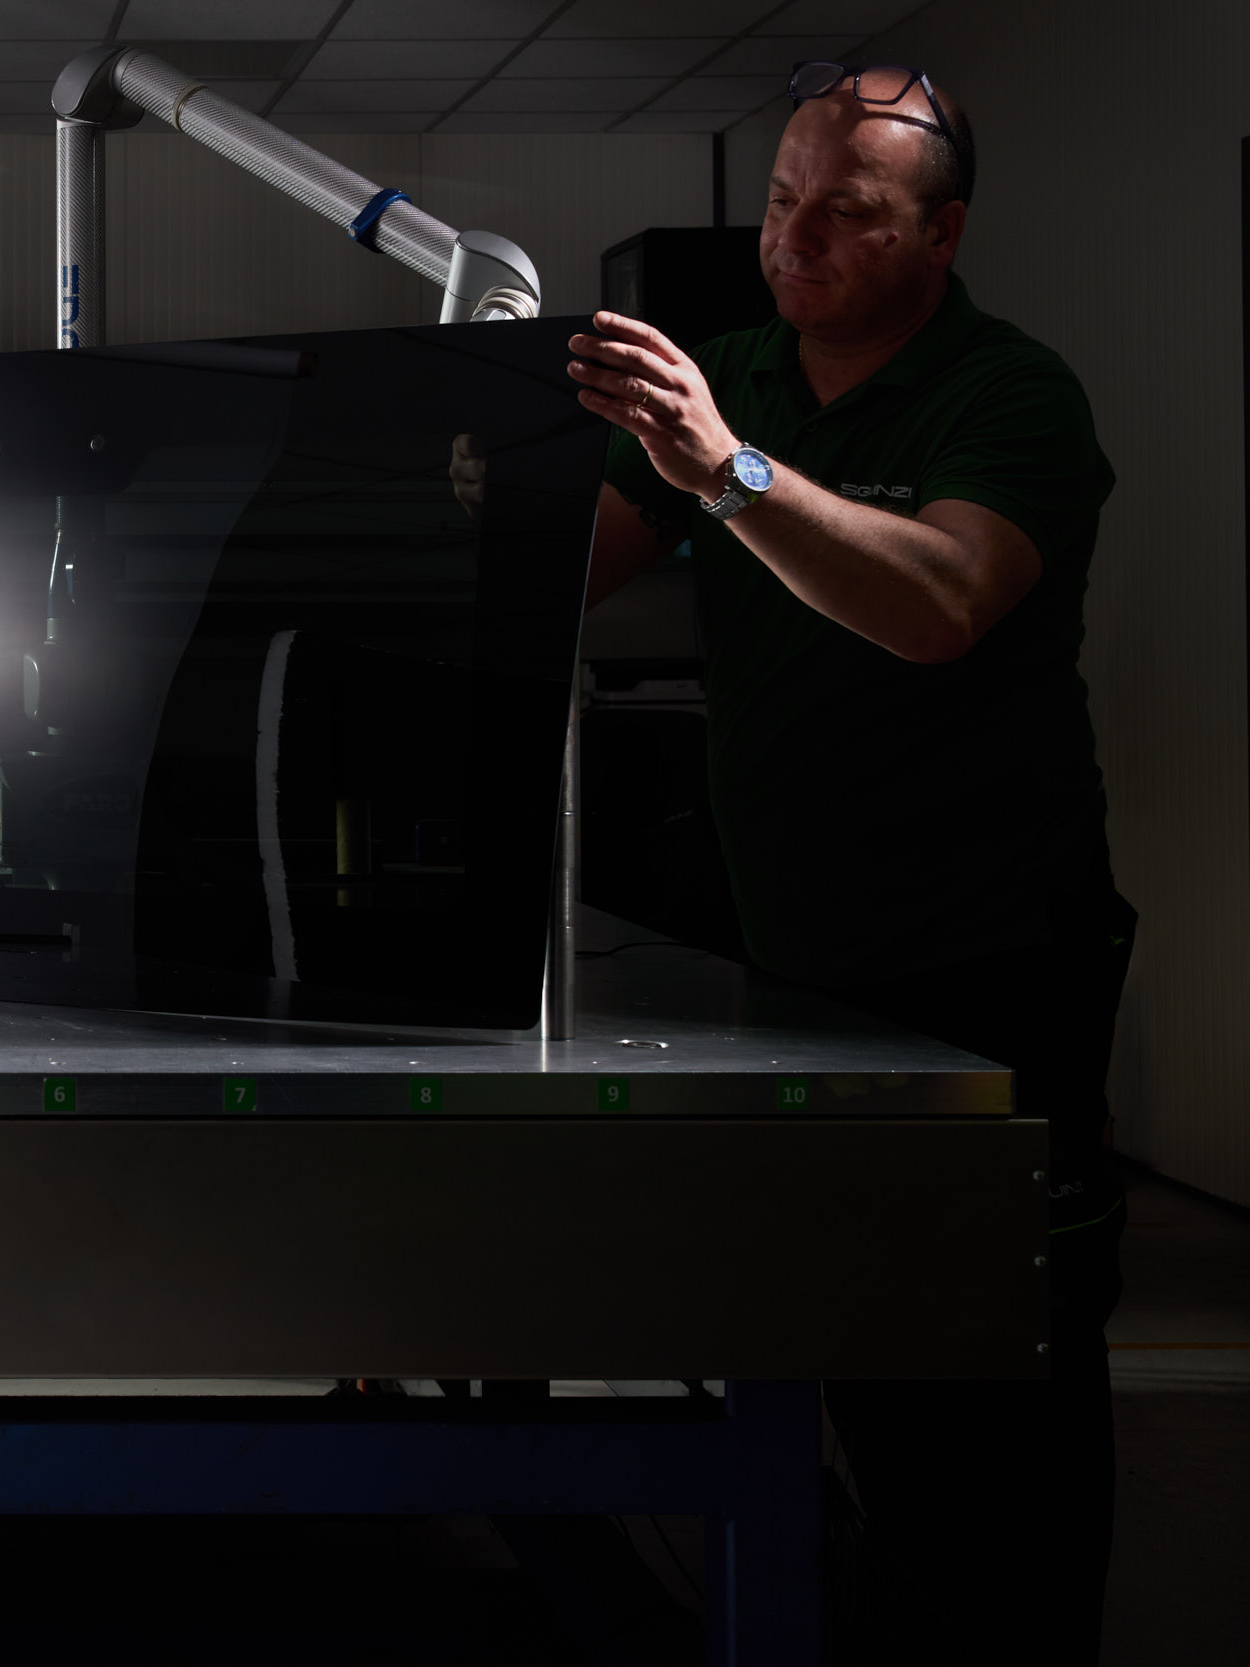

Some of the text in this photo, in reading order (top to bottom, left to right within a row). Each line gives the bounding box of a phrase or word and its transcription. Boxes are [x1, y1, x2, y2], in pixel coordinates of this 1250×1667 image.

[53, 1086, 65, 1103] 6
[234, 1087, 246, 1103] 7
[420, 1087, 432, 1104] 8
[606, 1085, 619, 1102] 9
[783, 1087, 806, 1104] 10
